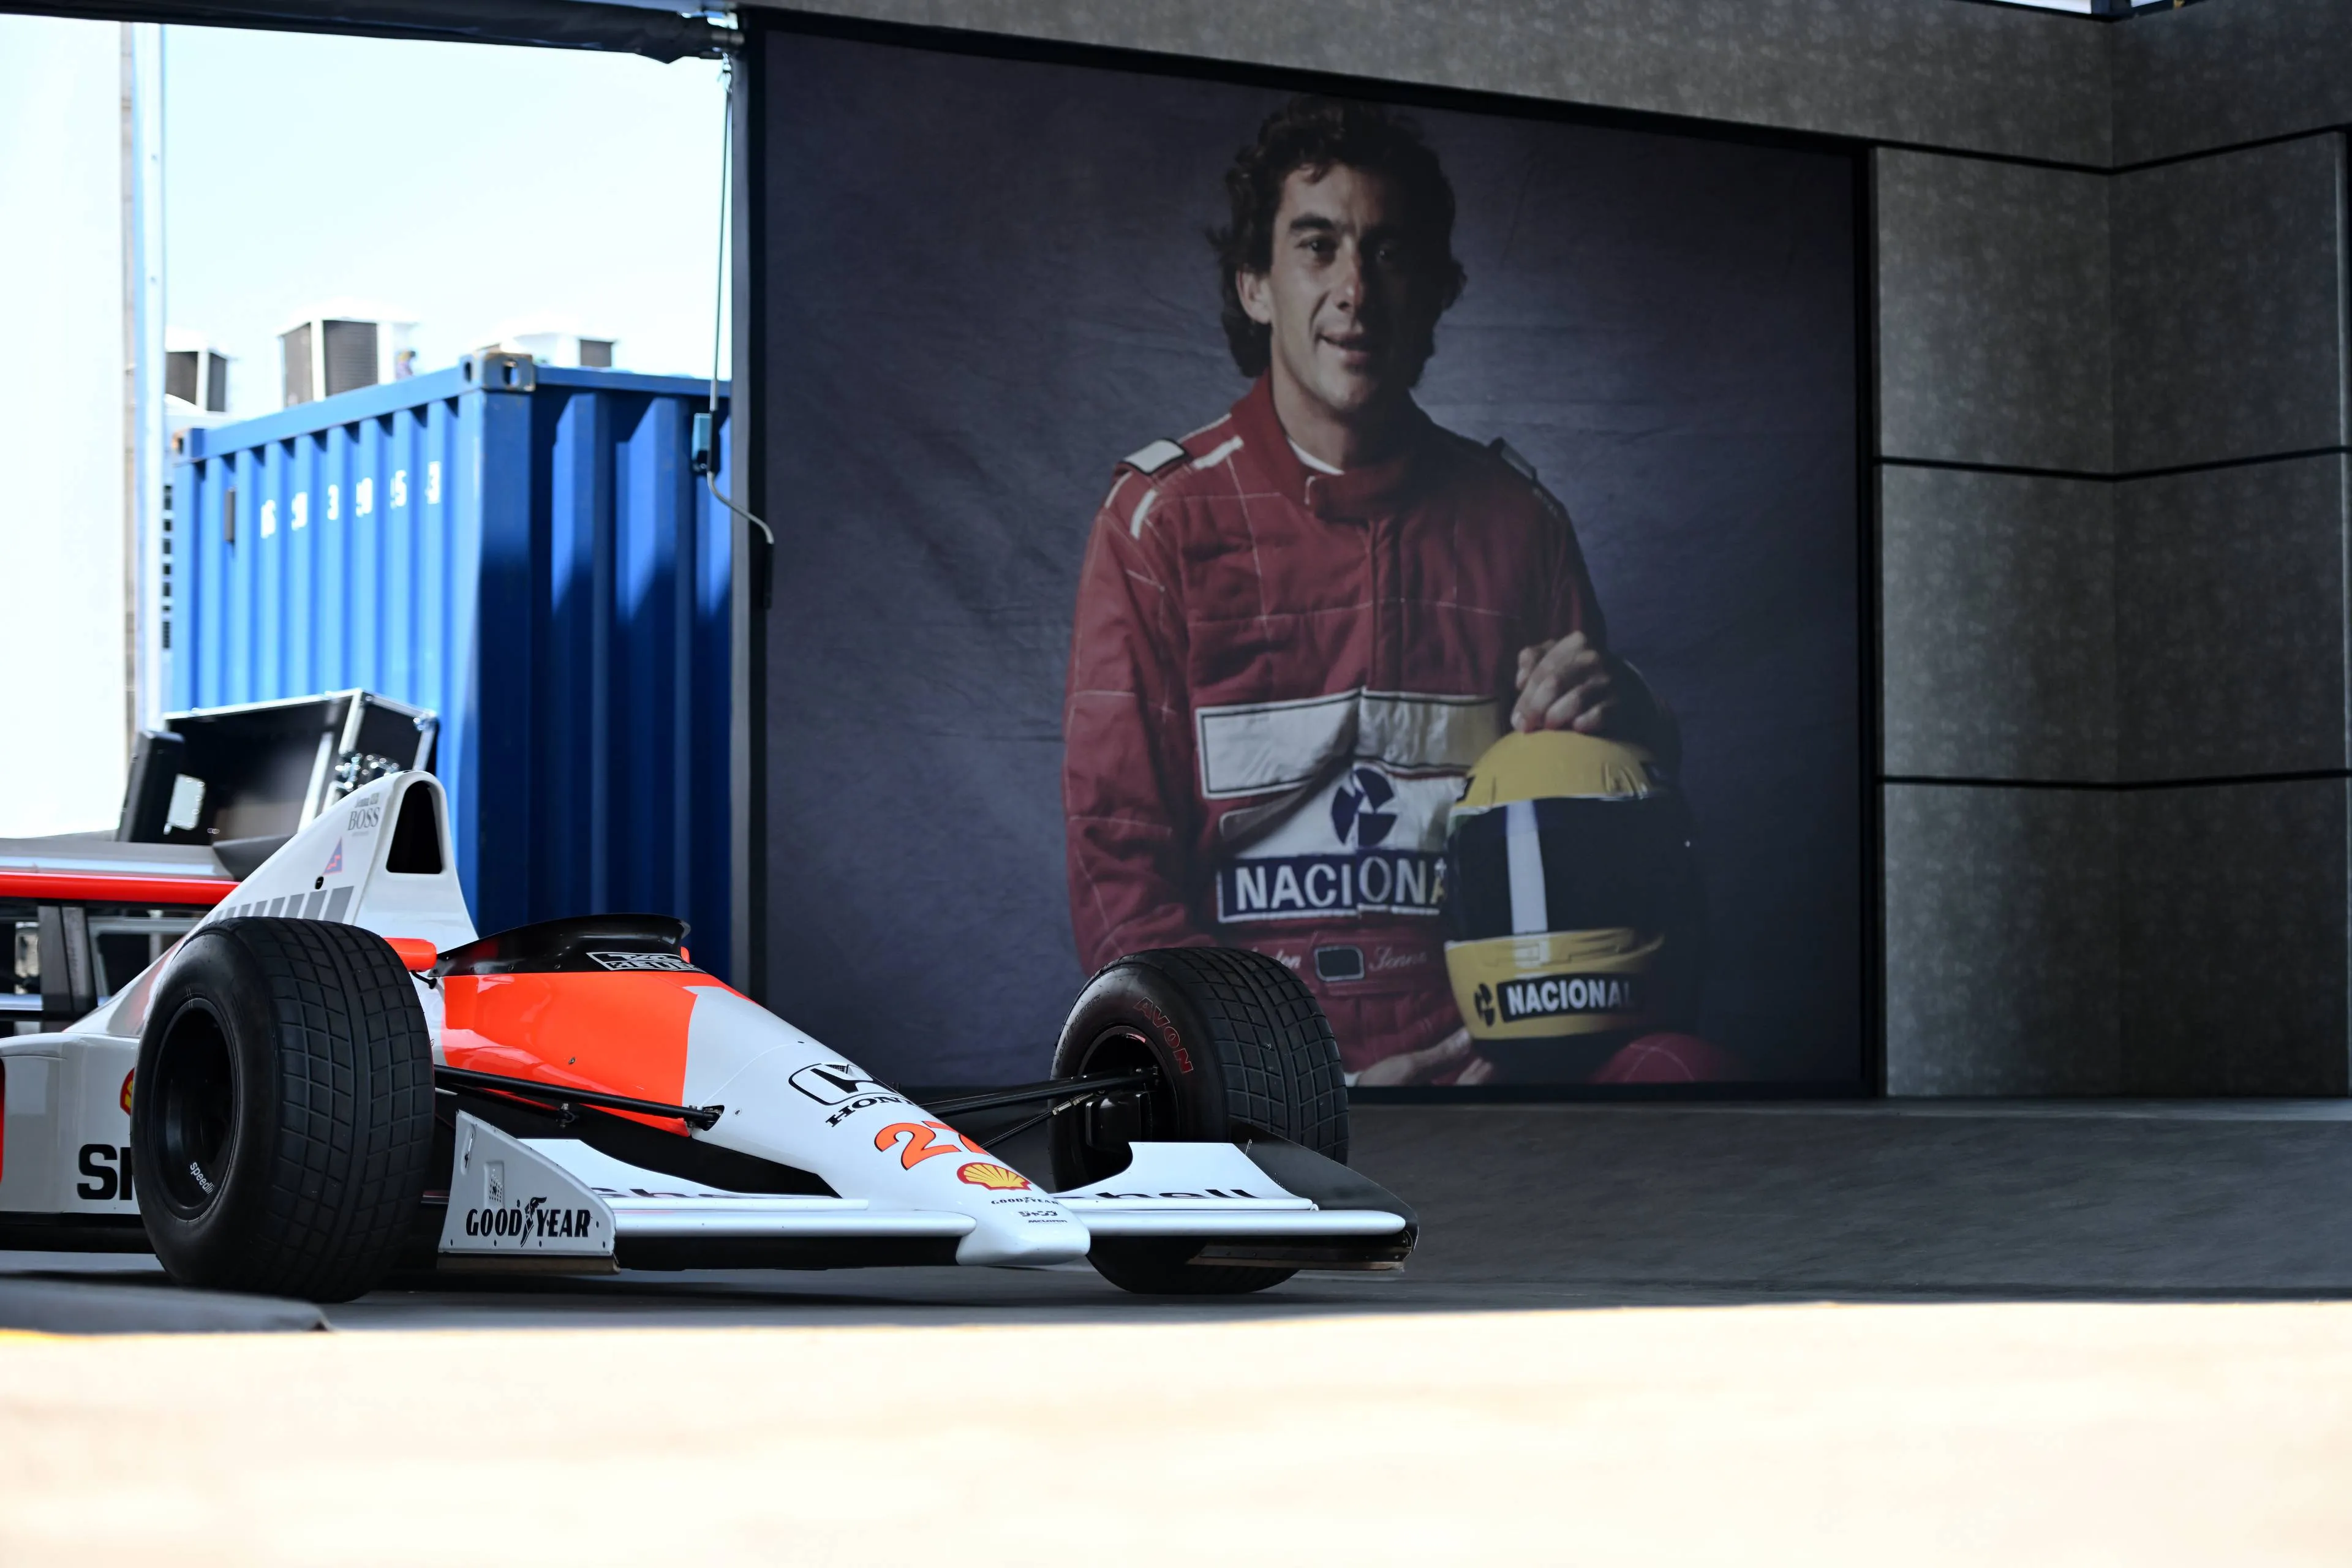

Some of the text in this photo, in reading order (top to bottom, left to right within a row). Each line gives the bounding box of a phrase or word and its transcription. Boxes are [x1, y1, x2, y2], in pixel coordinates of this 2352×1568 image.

[348, 807, 380, 831] BOSS
[1134, 997, 1194, 1074] AVON
[825, 1096, 916, 1128] HON
[190, 1162, 215, 1194] speedli
[1054, 1189, 1262, 1199] hell
